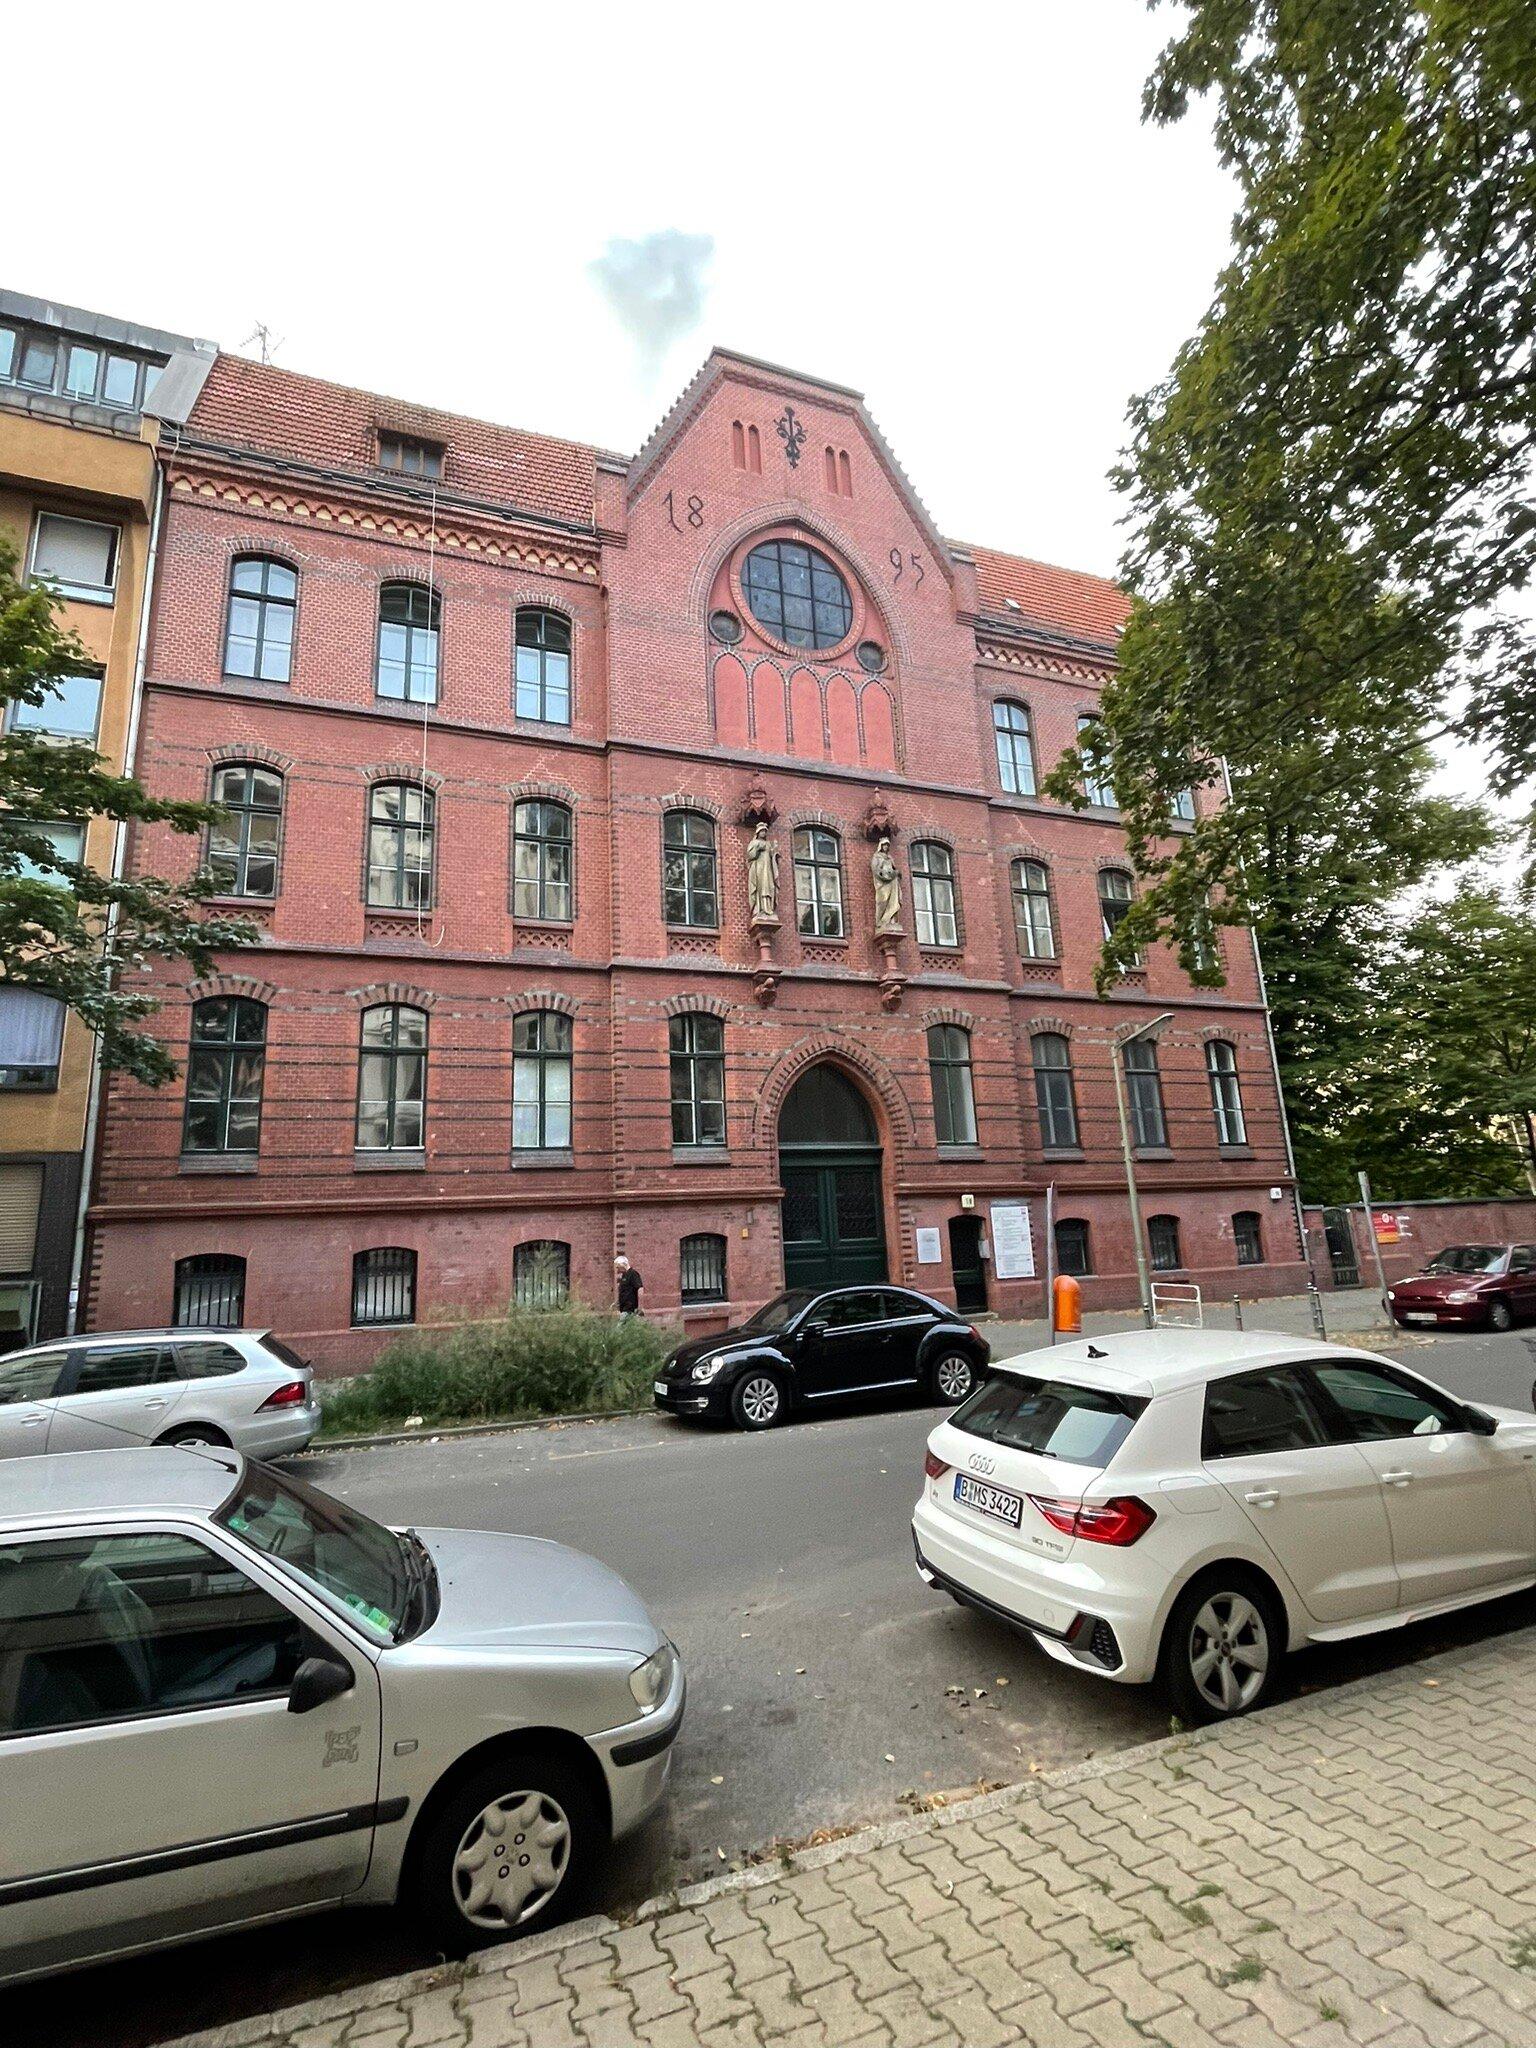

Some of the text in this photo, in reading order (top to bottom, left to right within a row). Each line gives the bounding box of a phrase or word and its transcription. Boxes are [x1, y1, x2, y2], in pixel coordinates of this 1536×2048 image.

[662, 489, 704, 533] 18
[889, 547, 925, 590] 95
[961, 1479, 968, 1497] B
[973, 1485, 988, 1506] MS
[989, 1491, 1018, 1520] 3422
